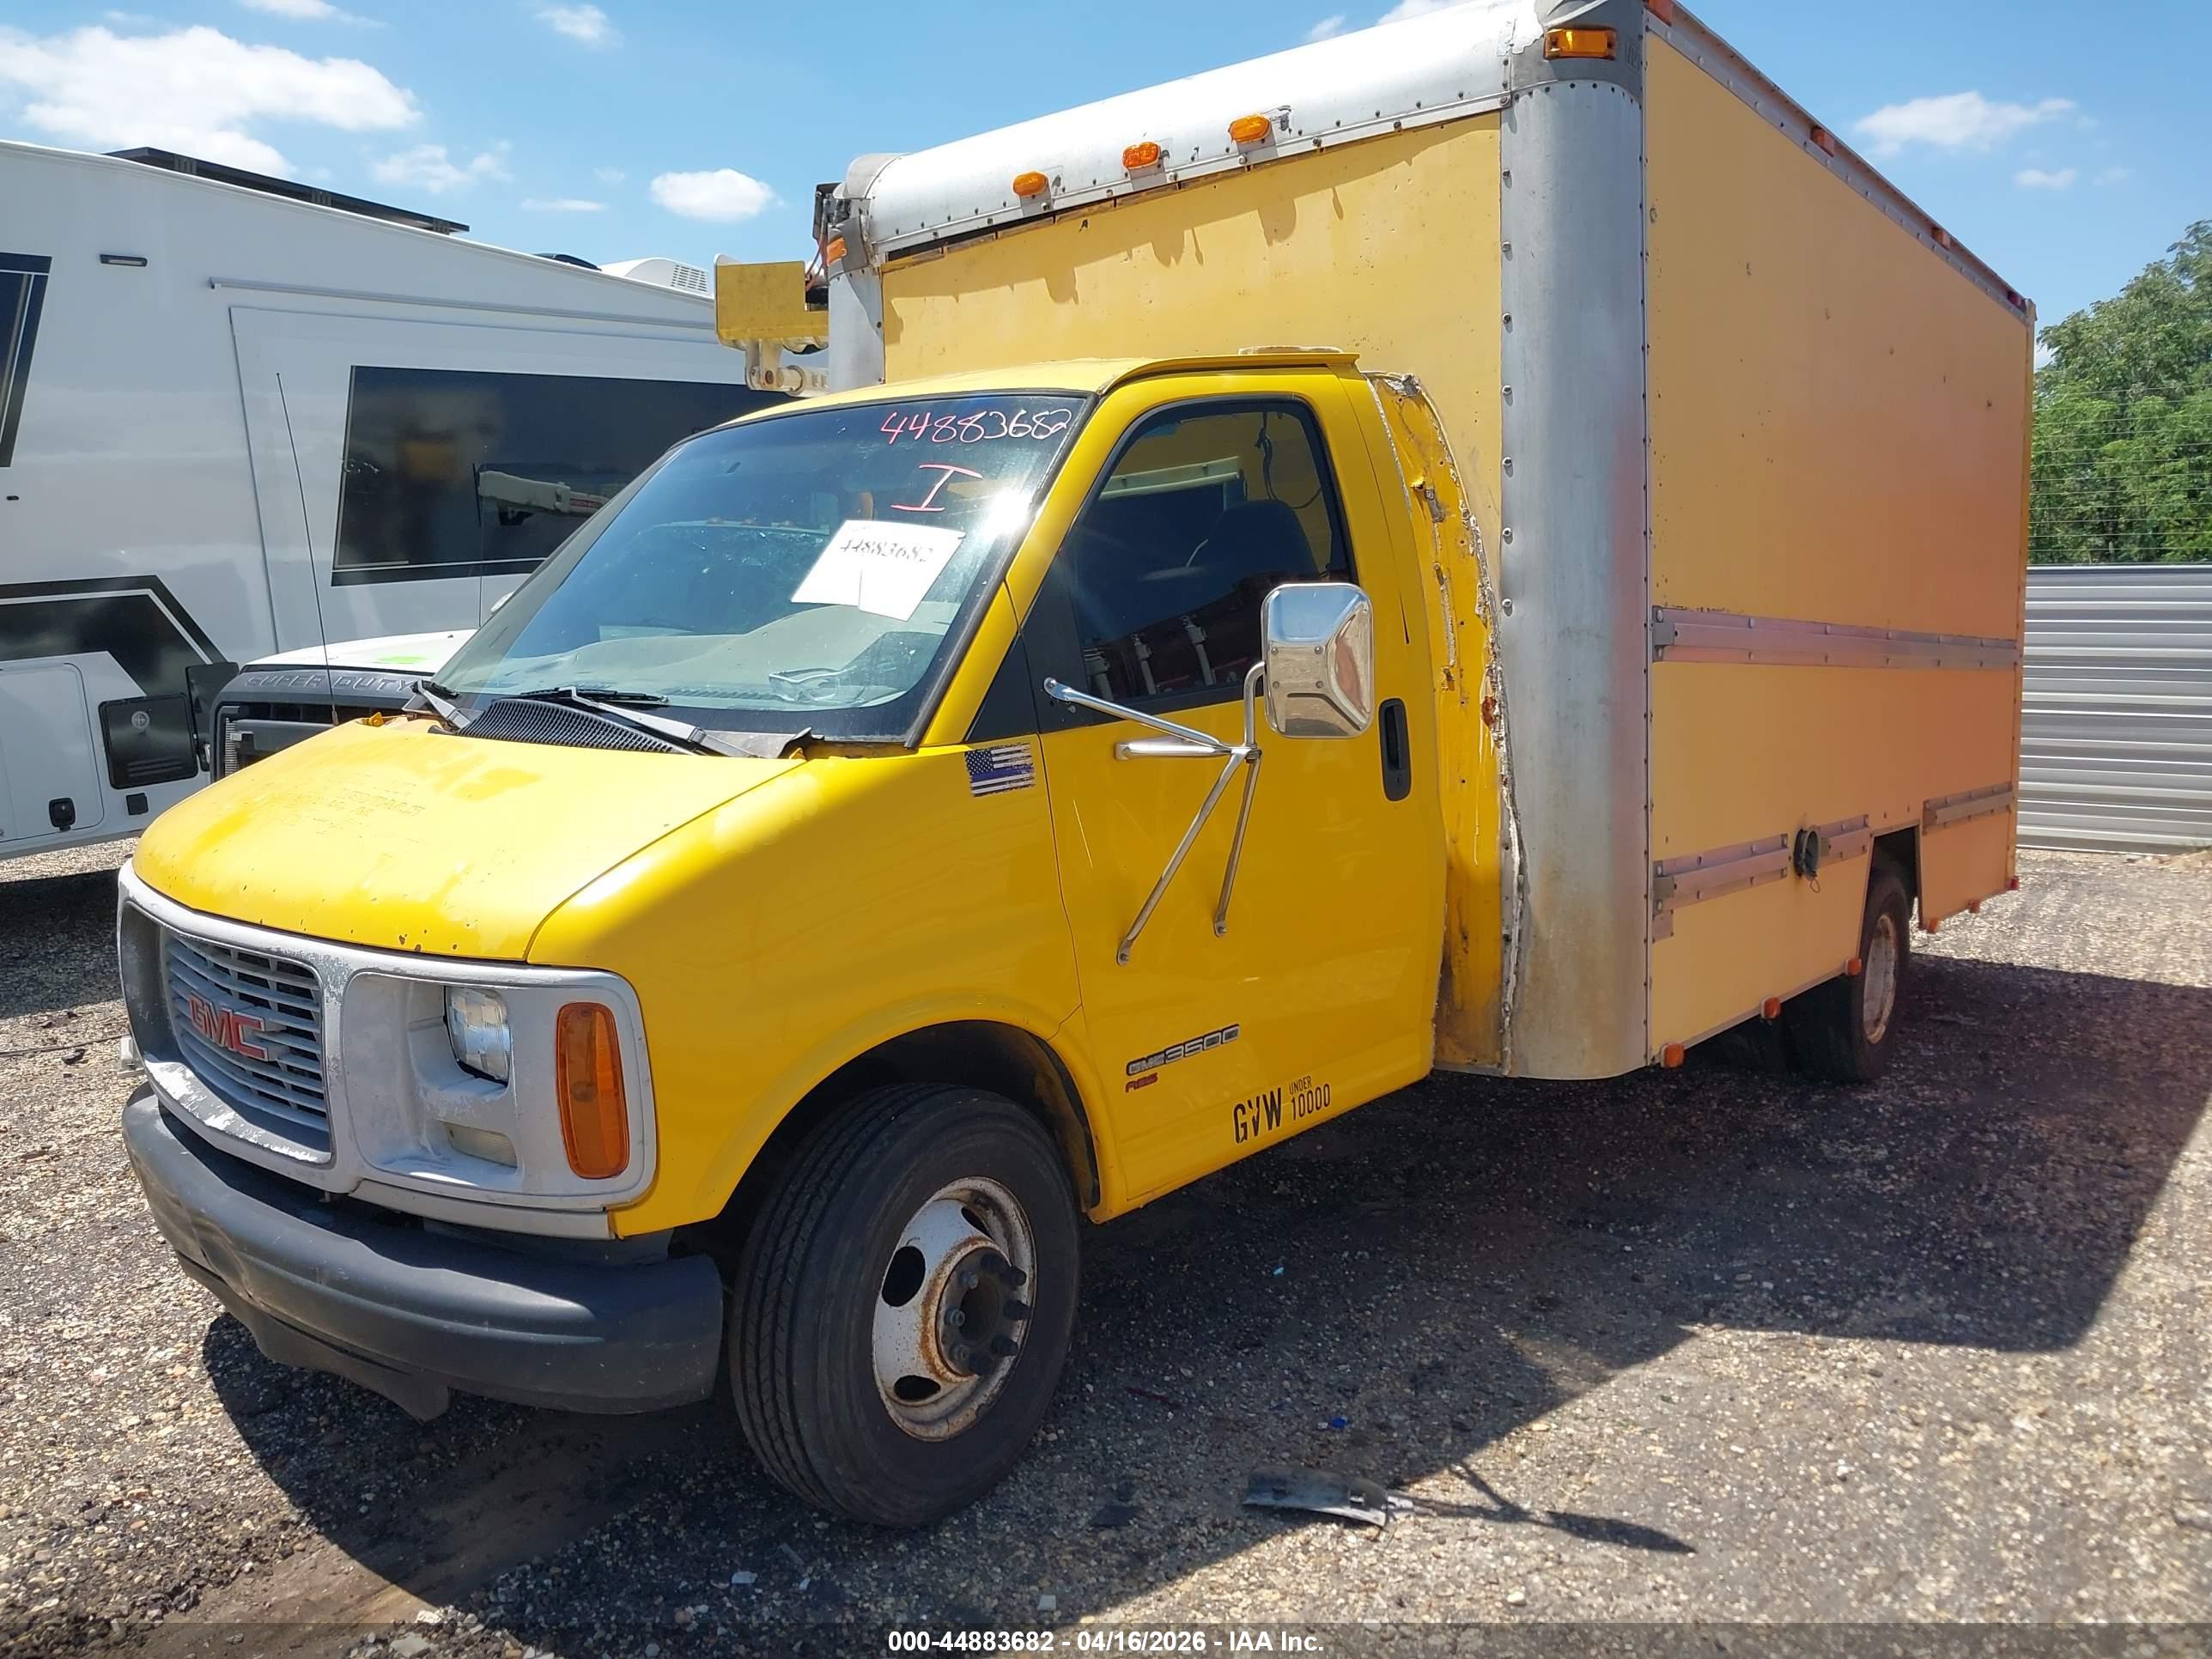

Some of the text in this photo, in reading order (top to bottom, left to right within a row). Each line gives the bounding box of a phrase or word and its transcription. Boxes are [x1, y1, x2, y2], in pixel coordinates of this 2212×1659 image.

[879, 408, 1073, 445] 44883682
[246, 674, 416, 691] SUPER DUTY
[188, 991, 269, 1062] GMC
[1233, 1075, 1313, 1145] GVW UNDER
[1291, 1083, 1331, 1121] 10000
